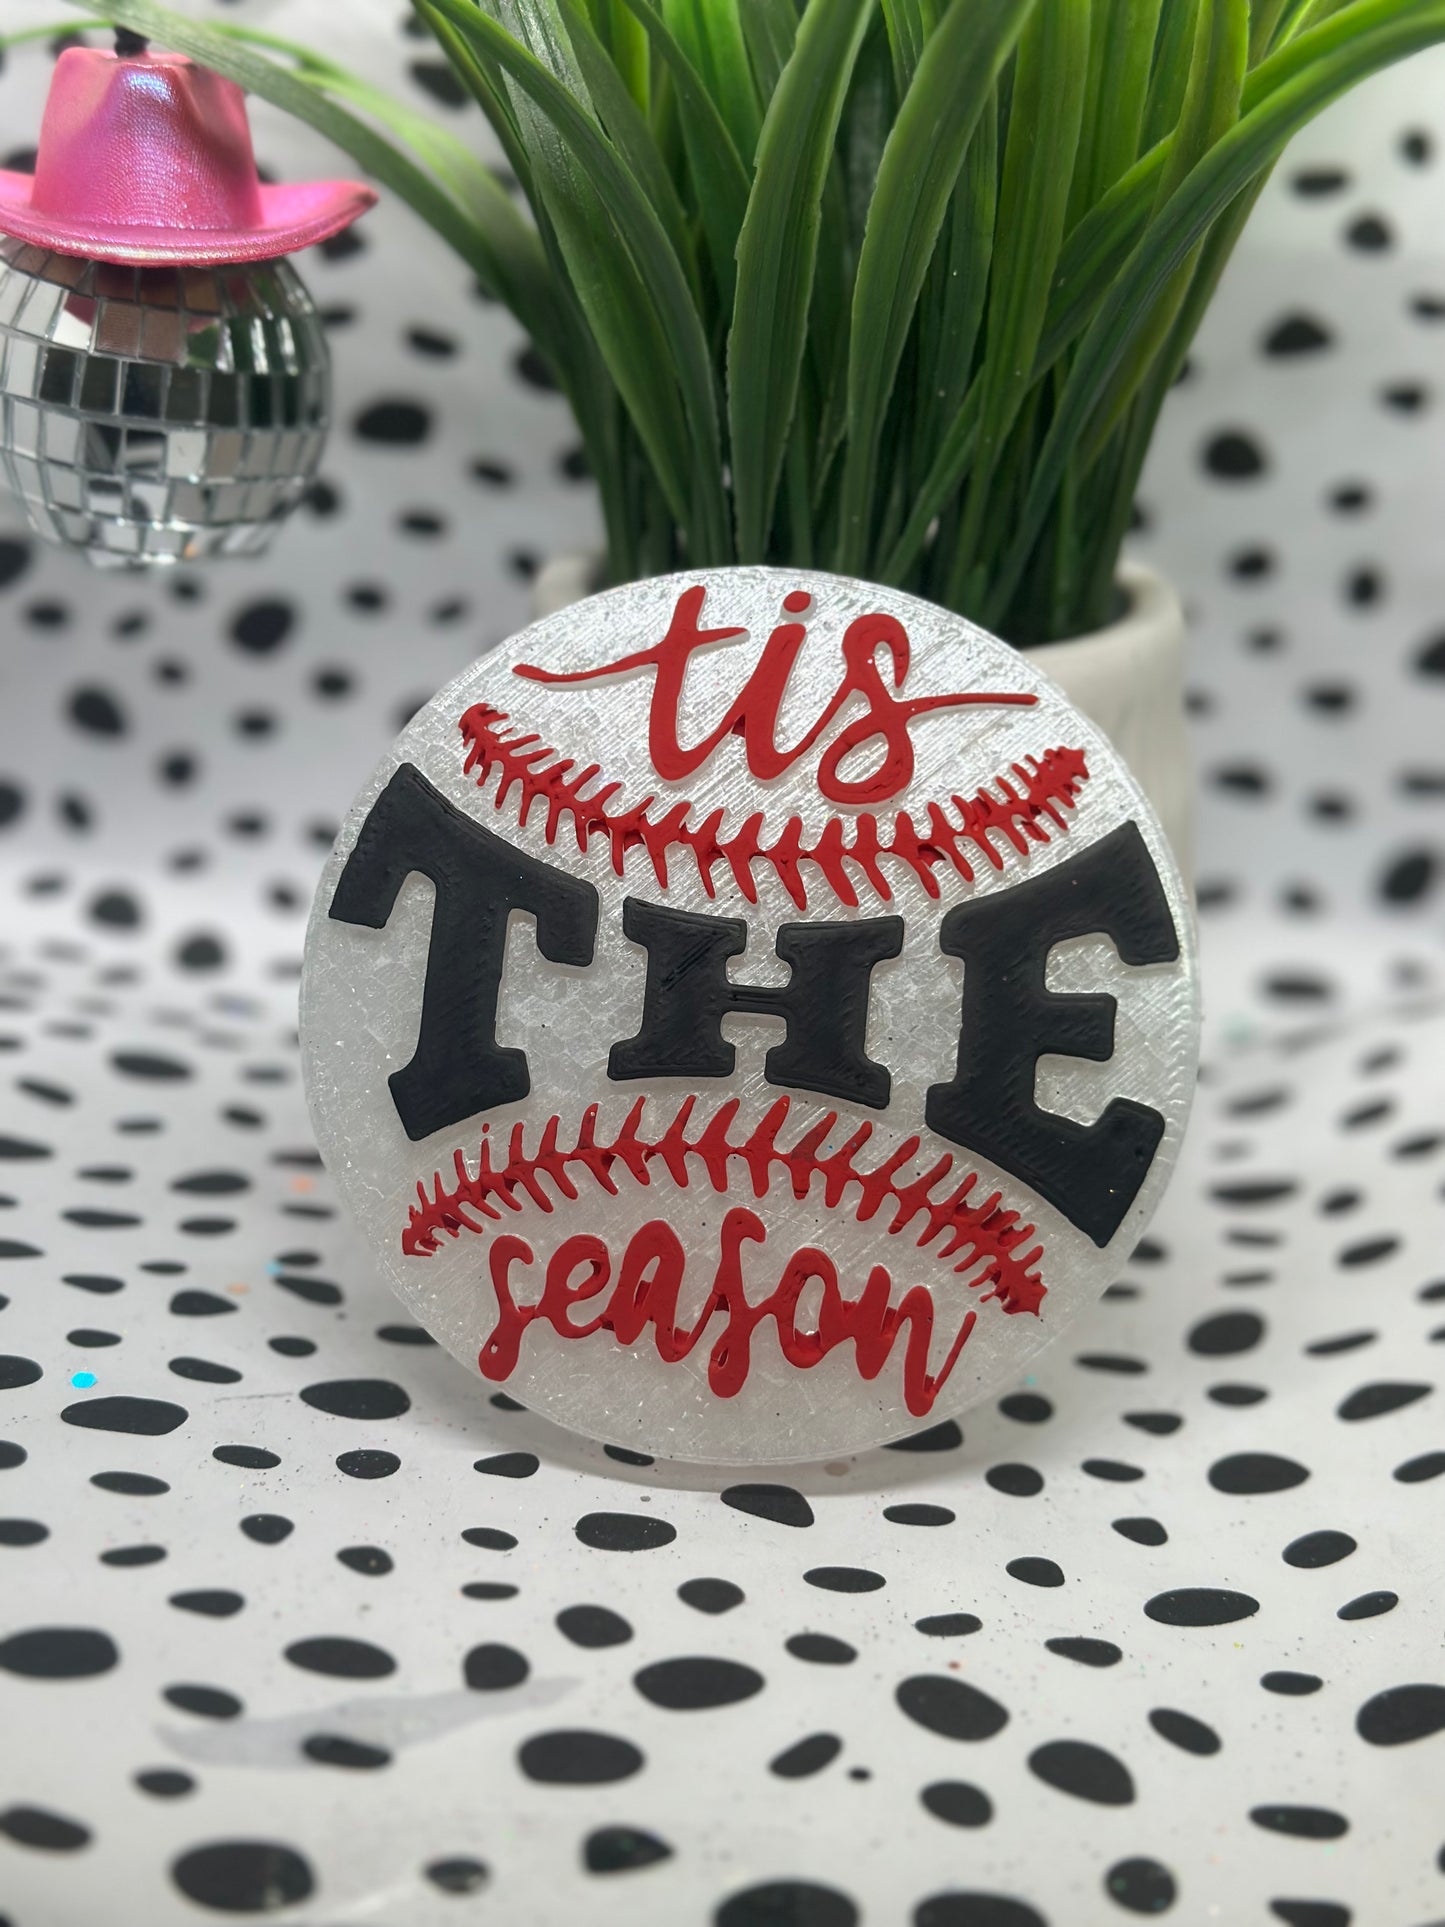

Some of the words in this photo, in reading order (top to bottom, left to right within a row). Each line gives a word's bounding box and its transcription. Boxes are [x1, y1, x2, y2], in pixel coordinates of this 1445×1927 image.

[514, 585, 1038, 805] tis
[328, 762, 1180, 1249] THE
[479, 1207, 977, 1418] season
